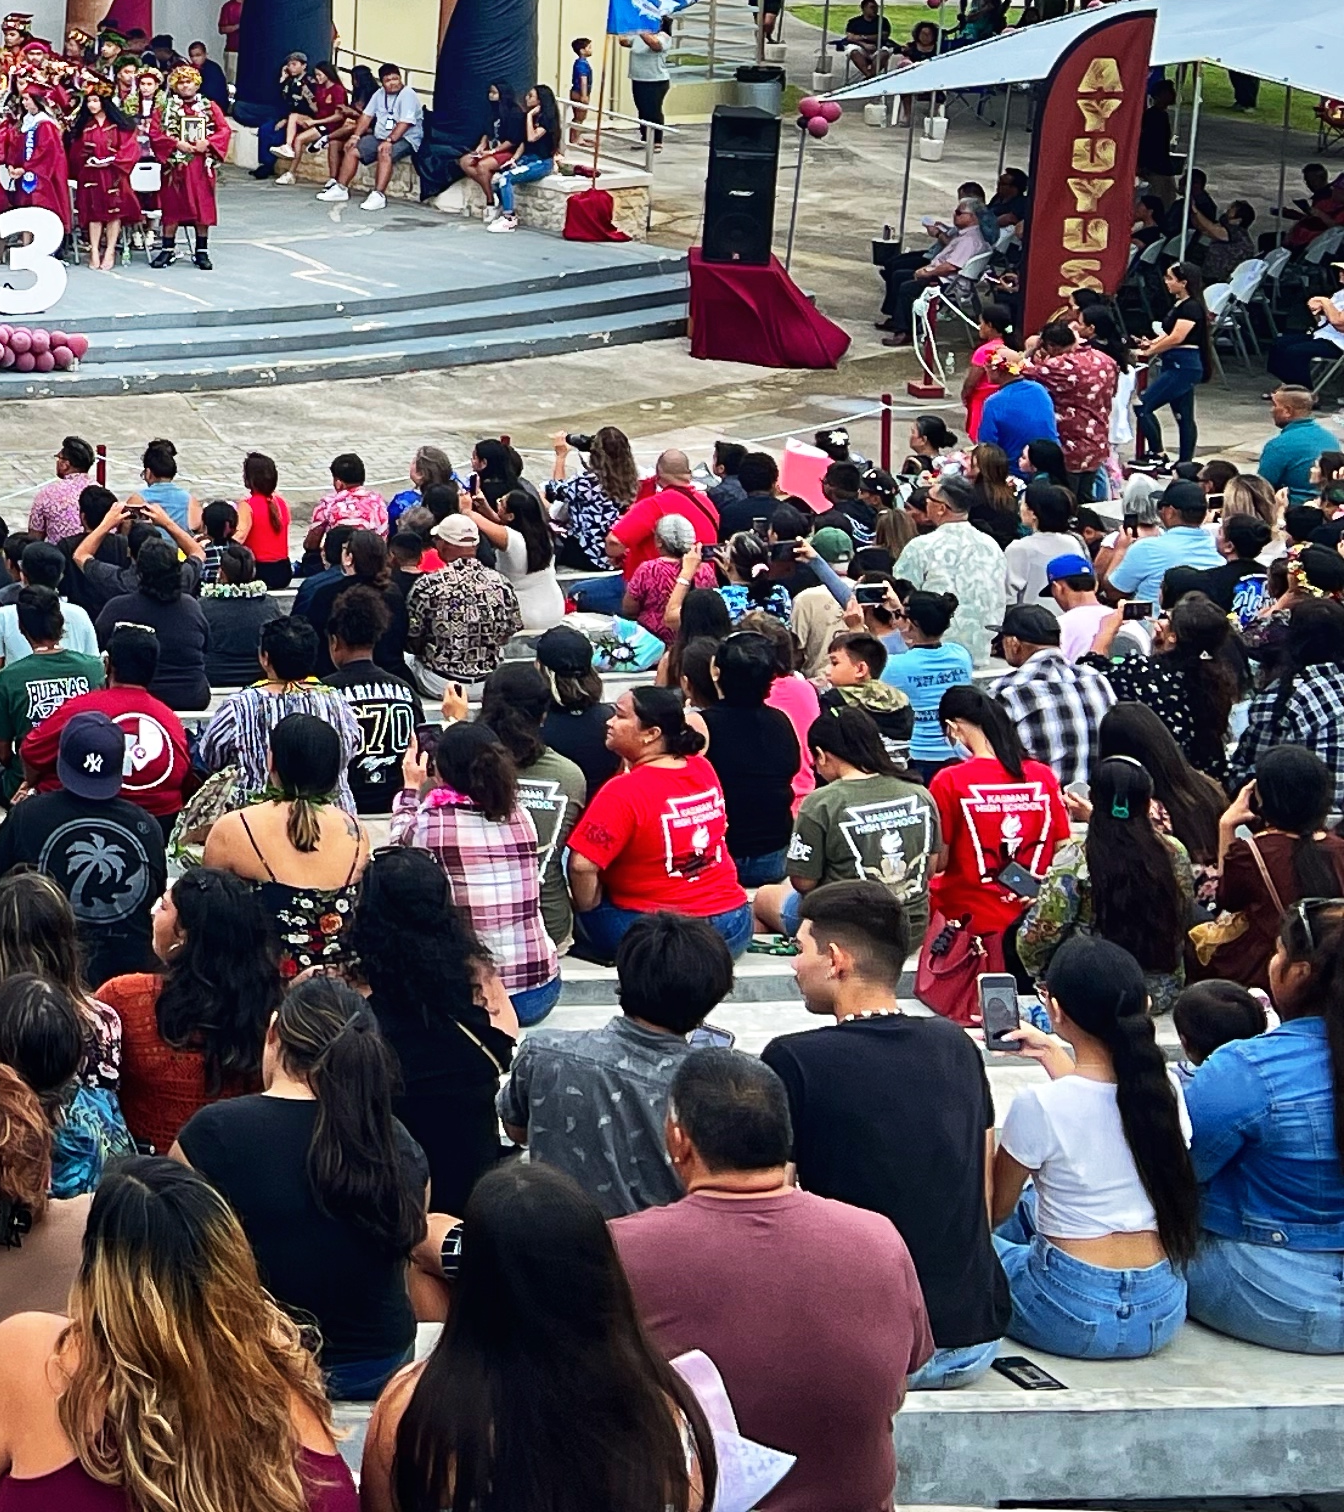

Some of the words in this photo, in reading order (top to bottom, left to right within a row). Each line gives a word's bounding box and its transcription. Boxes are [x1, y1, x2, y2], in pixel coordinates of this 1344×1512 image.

[1057, 57, 1125, 298] AYUYUS
[25, 676, 90, 710] BUENAS
[345, 681, 413, 703] ARIANAS
